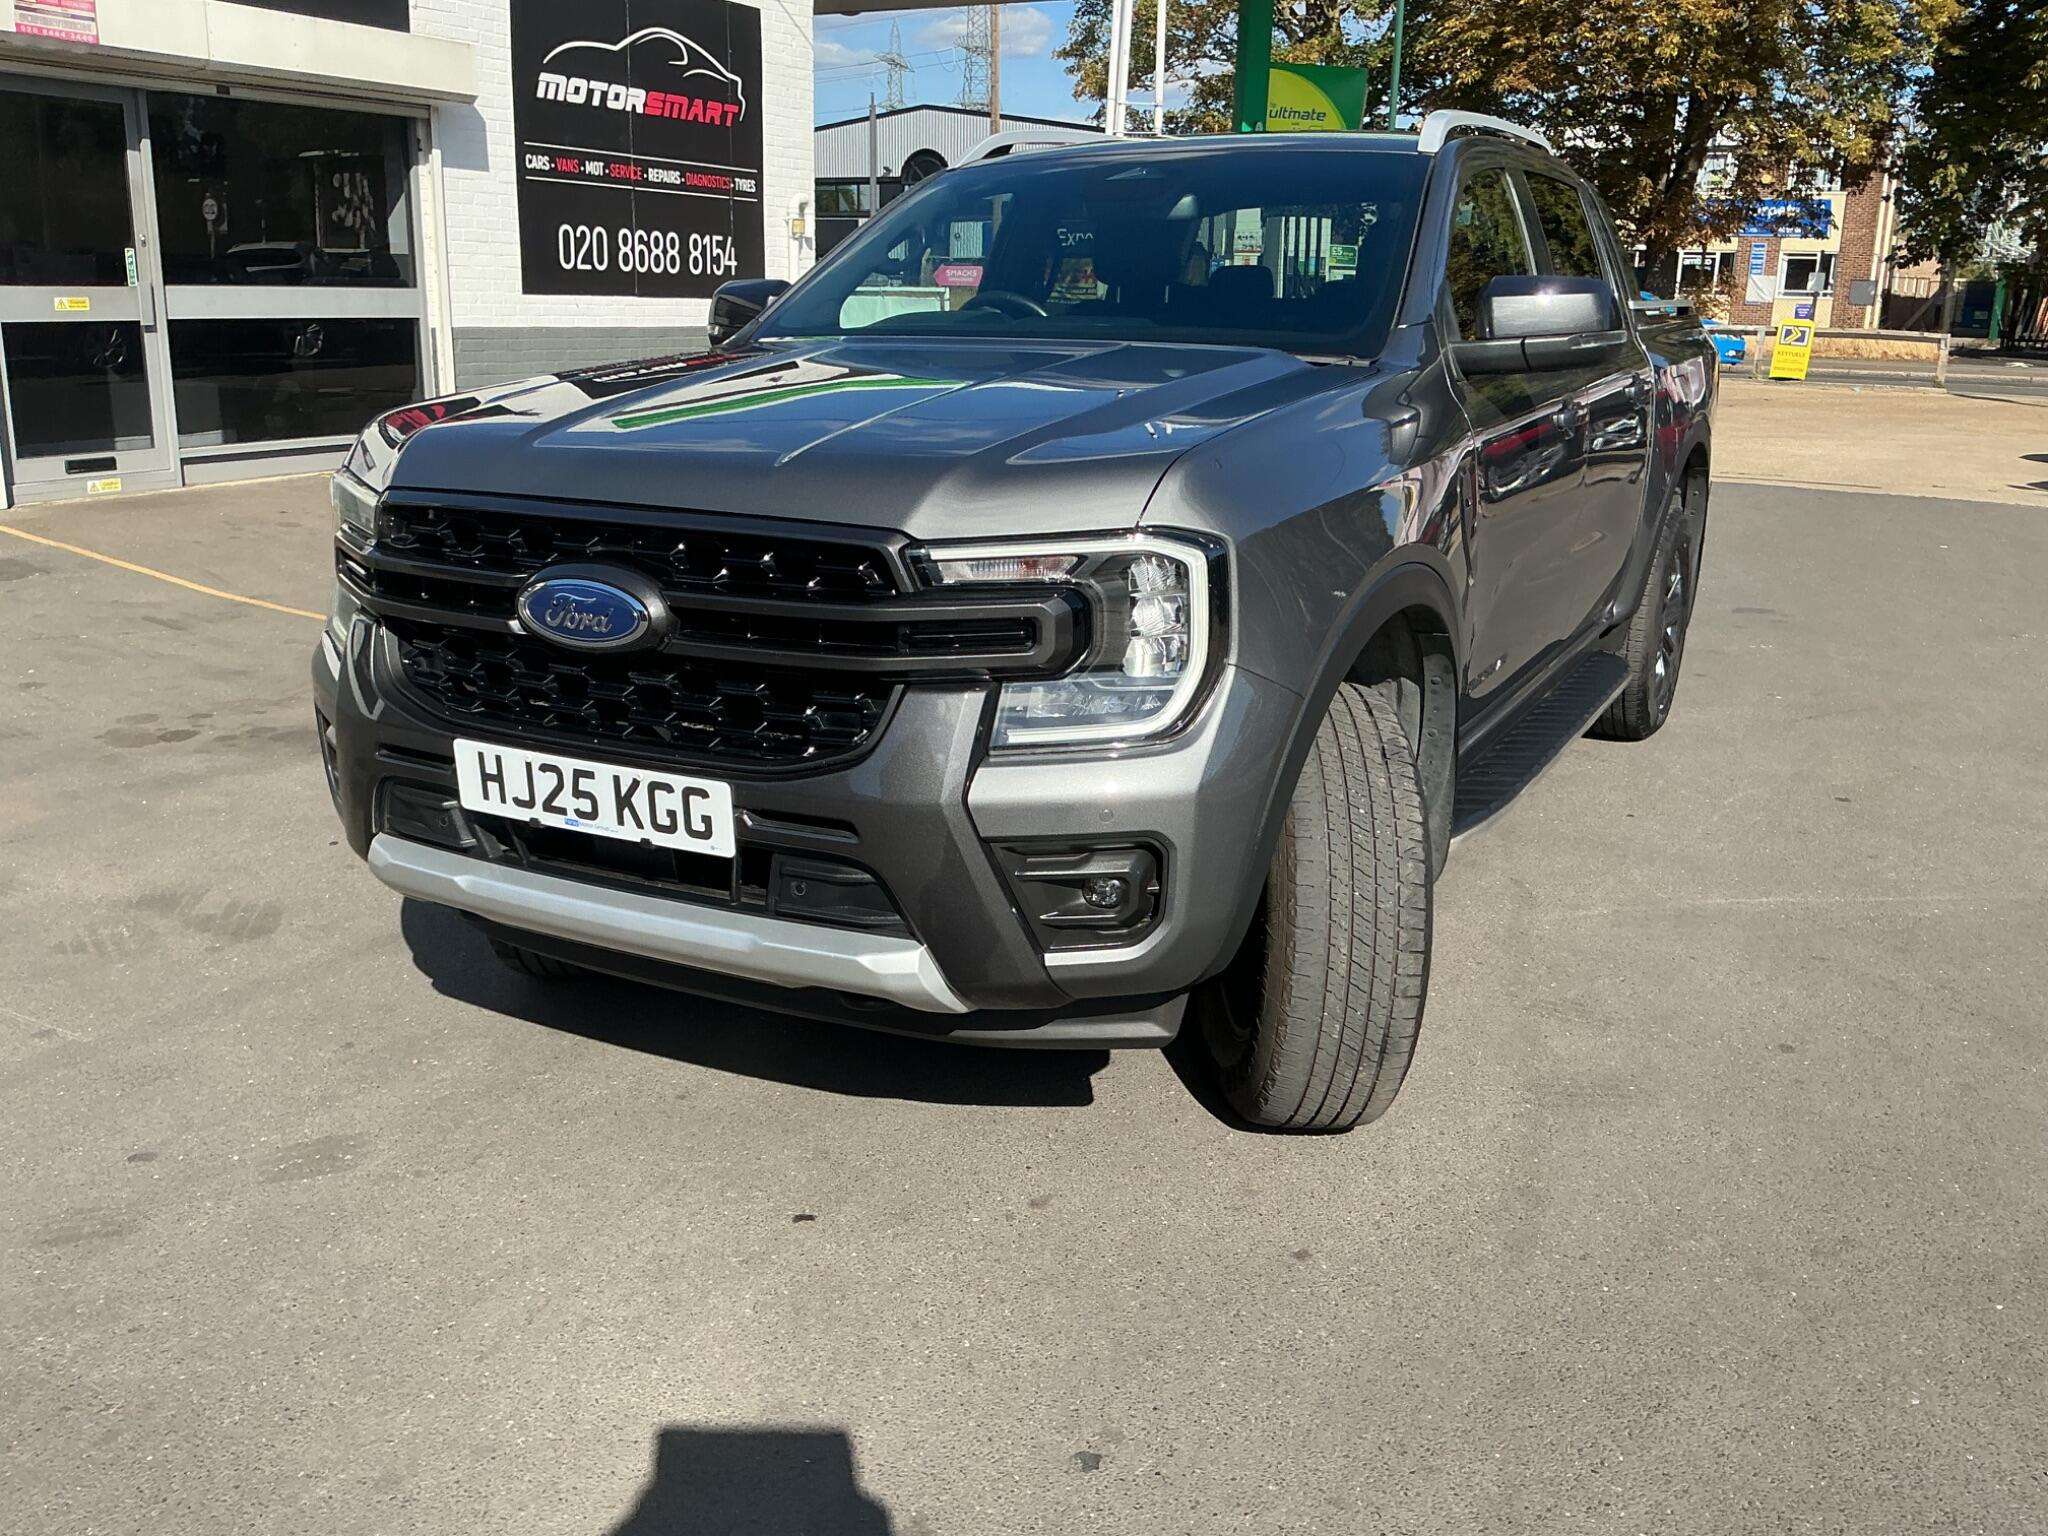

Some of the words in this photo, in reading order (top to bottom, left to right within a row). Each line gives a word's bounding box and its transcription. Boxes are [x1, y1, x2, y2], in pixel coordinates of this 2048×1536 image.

[536, 72, 739, 127] MOTORSMART
[1269, 107, 1327, 122] ultimate
[525, 154, 550, 171] CARS
[556, 157, 580, 174] VANS
[585, 160, 604, 176] MOT
[609, 163, 643, 180] SERVICE
[648, 168, 681, 184] REPAIRS
[685, 172, 731, 190] DIAGNOSTICS
[734, 178, 757, 193] TYRES
[558, 224, 609, 271] 020
[618, 228, 681, 275] 8688
[689, 233, 738, 276] 8154
[545, 592, 614, 634] Ford
[477, 751, 600, 821] HJ25
[612, 774, 714, 841] KGG
